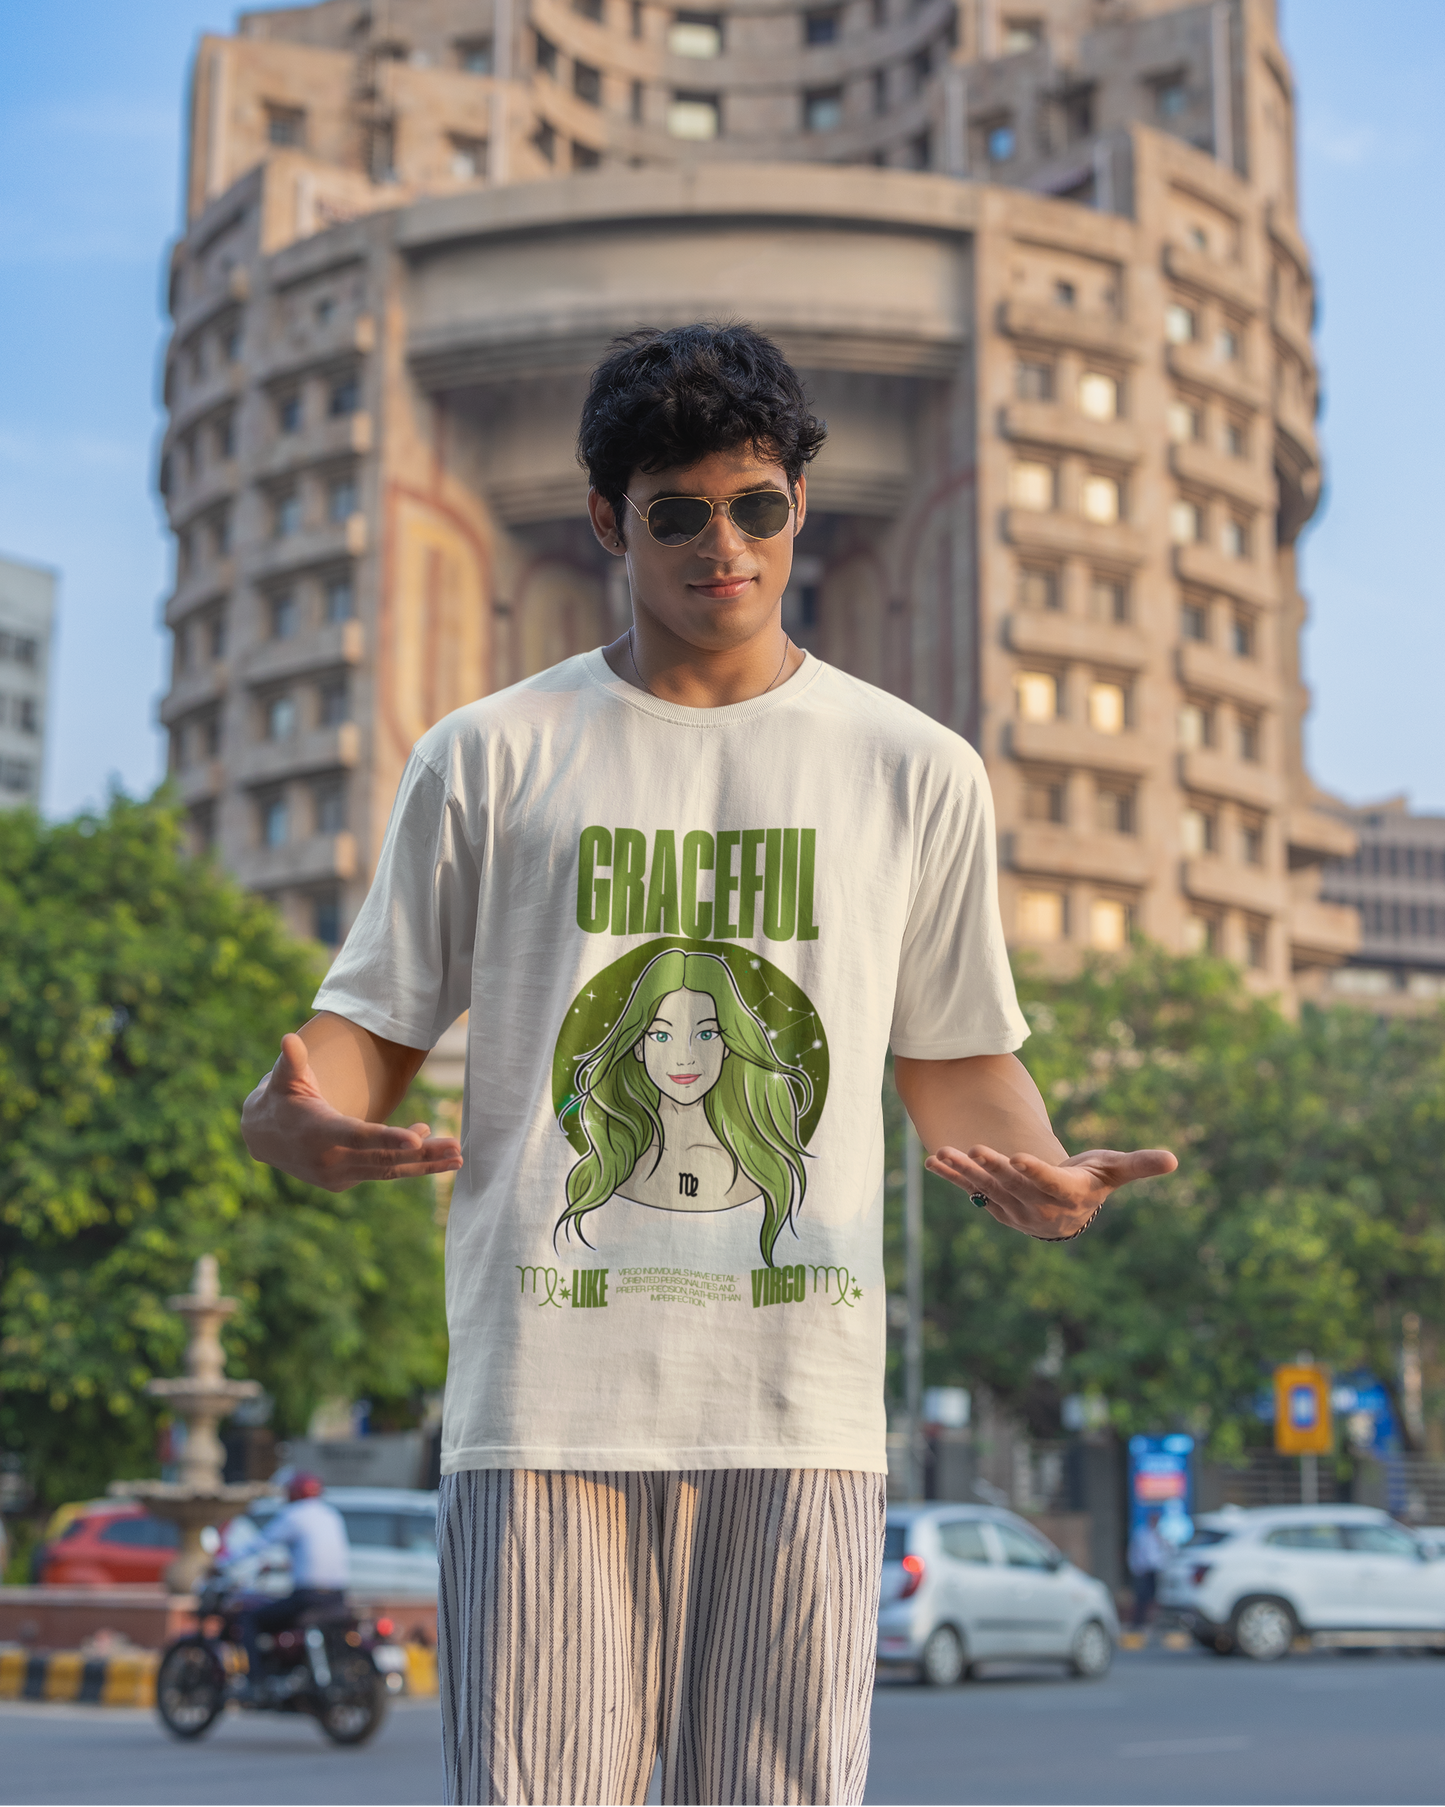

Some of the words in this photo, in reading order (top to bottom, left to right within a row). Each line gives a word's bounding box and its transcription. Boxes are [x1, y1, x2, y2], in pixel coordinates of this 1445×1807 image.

[576, 825, 819, 942] GRACEFUL
[571, 1268, 609, 1308] LIKE
[617, 1267, 642, 1276] VIRGO
[643, 1267, 689, 1277] INDIVIDUALS
[690, 1270, 710, 1281] HAVE
[622, 1276, 660, 1285] ORIENTED
[661, 1276, 718, 1291] PERSONALITIES
[719, 1284, 736, 1292] AND
[751, 1264, 806, 1308] VIRGO
[616, 1285, 646, 1294] PREFER
[689, 1288, 719, 1300] RATHER
[720, 1293, 741, 1302] THAN
